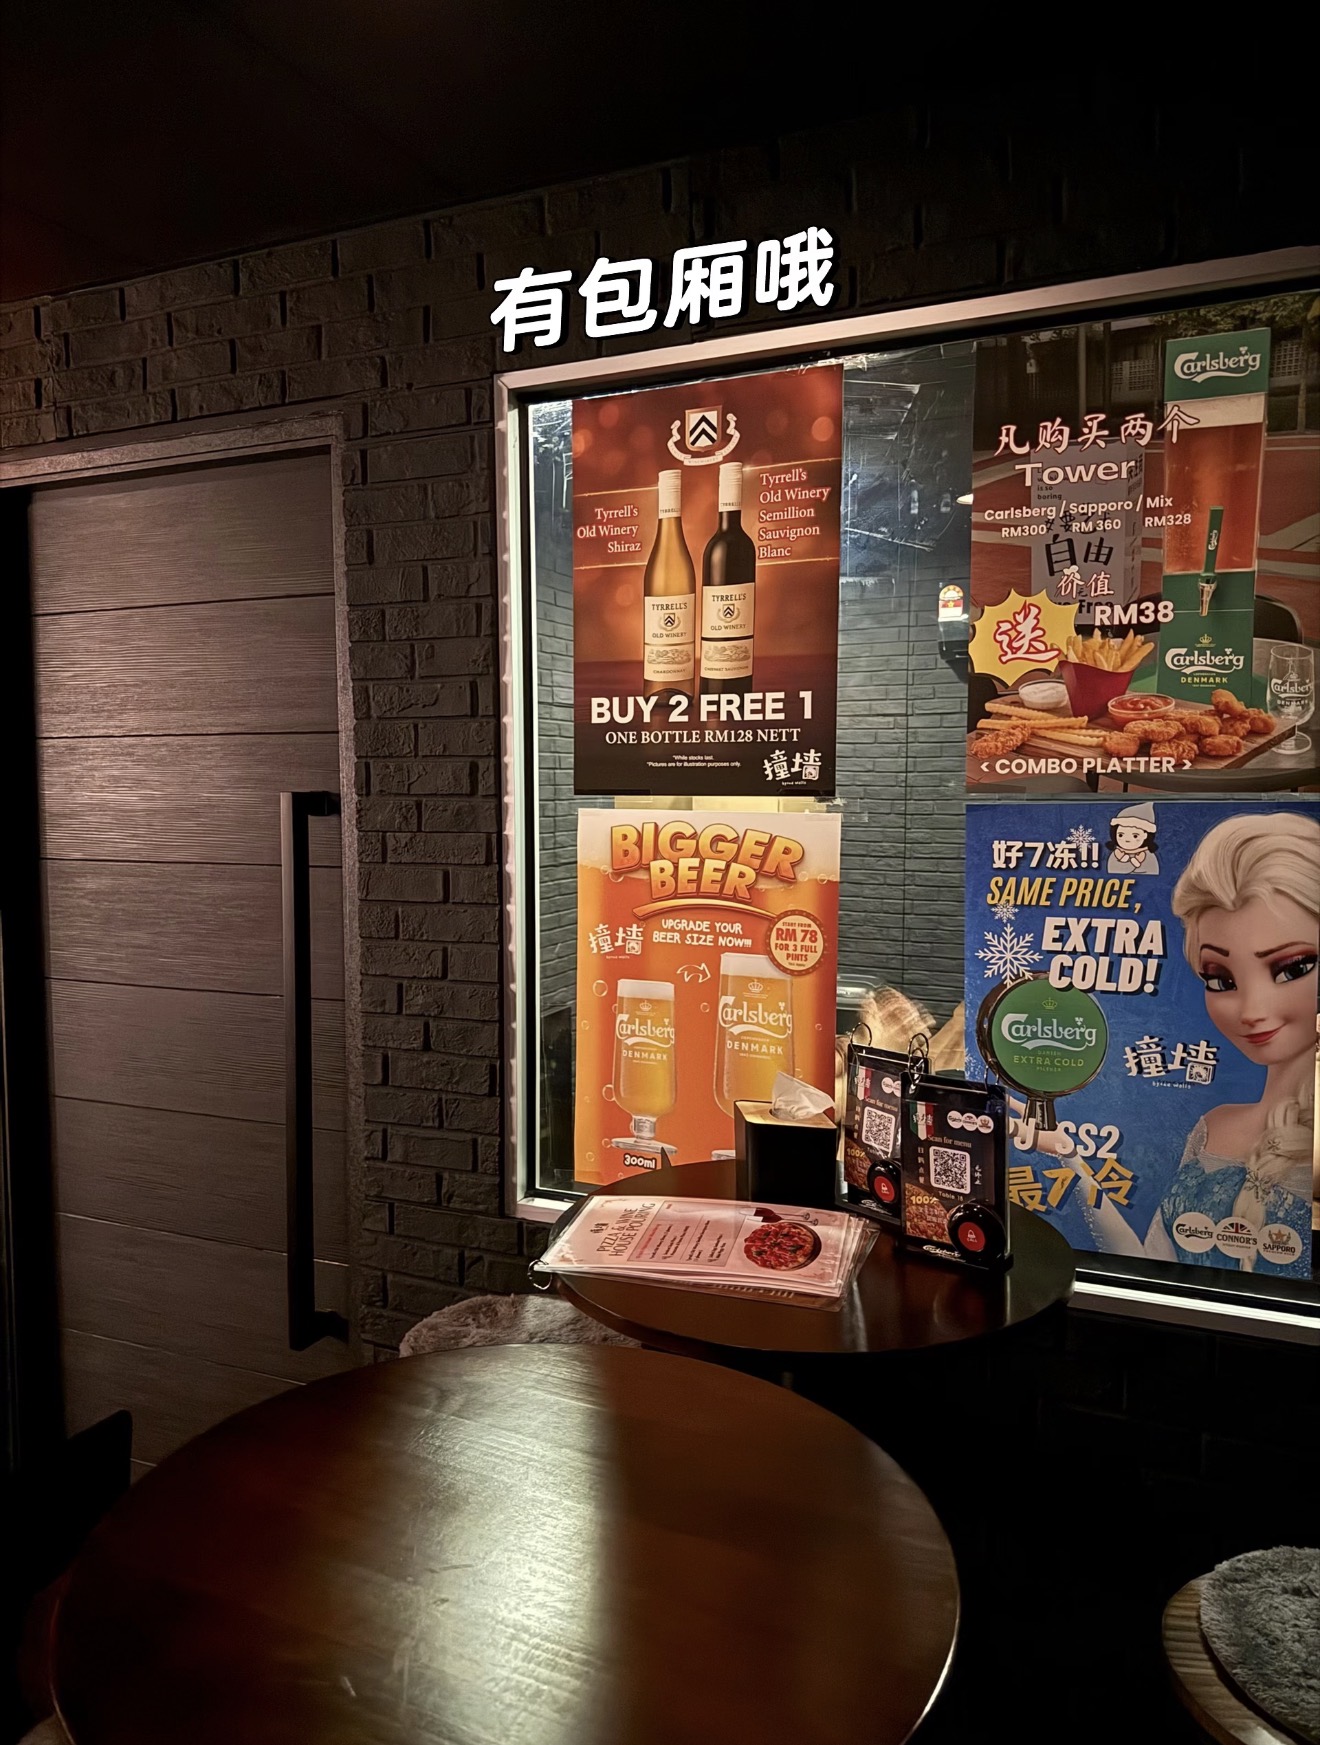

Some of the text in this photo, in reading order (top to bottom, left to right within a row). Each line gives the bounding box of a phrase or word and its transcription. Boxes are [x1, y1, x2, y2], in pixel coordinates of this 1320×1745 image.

[490, 226, 834, 352] 有包厢哦
[1174, 346, 1261, 383] Carlsberg
[994, 404, 1200, 456] 凡购买两个
[1014, 460, 1136, 487] Tower
[760, 487, 832, 504] Old Winery
[984, 505, 1056, 521] Carlsberg
[1069, 501, 1133, 516] Sapporo
[1146, 495, 1173, 508] Mix
[759, 506, 815, 522] Semillion
[1001, 524, 1047, 538] RM300
[1072, 521, 1093, 533] RM
[1096, 518, 1121, 531] 360
[1145, 513, 1192, 527] RM328
[577, 524, 639, 539] Old Winery
[759, 526, 820, 541] Sauvignon
[607, 542, 641, 553] Shiraz
[759, 545, 792, 558] Blanc
[1045, 533, 1114, 576] 自由
[1057, 571, 1114, 599] 价值
[1095, 601, 1174, 627] RM38
[994, 603, 1062, 664] 送
[1165, 648, 1245, 675] Carlsberg
[1180, 676, 1229, 684] DENMARK
[590, 690, 813, 724] BUY 2 FREE 1
[605, 728, 800, 744] ONE BOTTLE RM128 NETT
[995, 757, 1175, 774] COMBO PLATTER
[611, 820, 805, 882] BIGGER
[992, 840, 1099, 870] 好7冻!!
[650, 857, 757, 902] BEER
[986, 876, 1142, 914] SAME PRICE,
[653, 931, 681, 944] BEER
[685, 933, 714, 946] SIZE
[661, 918, 743, 934] UPGRADE YOUR
[776, 928, 818, 943] RM 78
[1041, 916, 1164, 956] EXTRA
[775, 943, 818, 953] FOR 3 FULL
[786, 953, 808, 962] PINTS
[1049, 954, 1159, 994] COLD!
[719, 995, 793, 1039] Carlsberg
[616, 1013, 675, 1048] Carlsberg
[1001, 1013, 1097, 1051] Carlsberg
[622, 1049, 667, 1060] DENMARK
[726, 1040, 783, 1055] DENMARK
[1013, 1055, 1084, 1067] EXTRA COLD
[1055, 1121, 1120, 1159] SS2
[623, 1153, 657, 1170] 300ml
[910, 1195, 939, 1205] 100%
[596, 1231, 622, 1252] PIZZA
[615, 1208, 639, 1224] WINE
[1176, 1223, 1213, 1239] Carlsberg
[1216, 1233, 1258, 1246] CONNOR'S
[608, 1232, 637, 1257] HOUSE
[1262, 1242, 1296, 1254] SAPPORO
